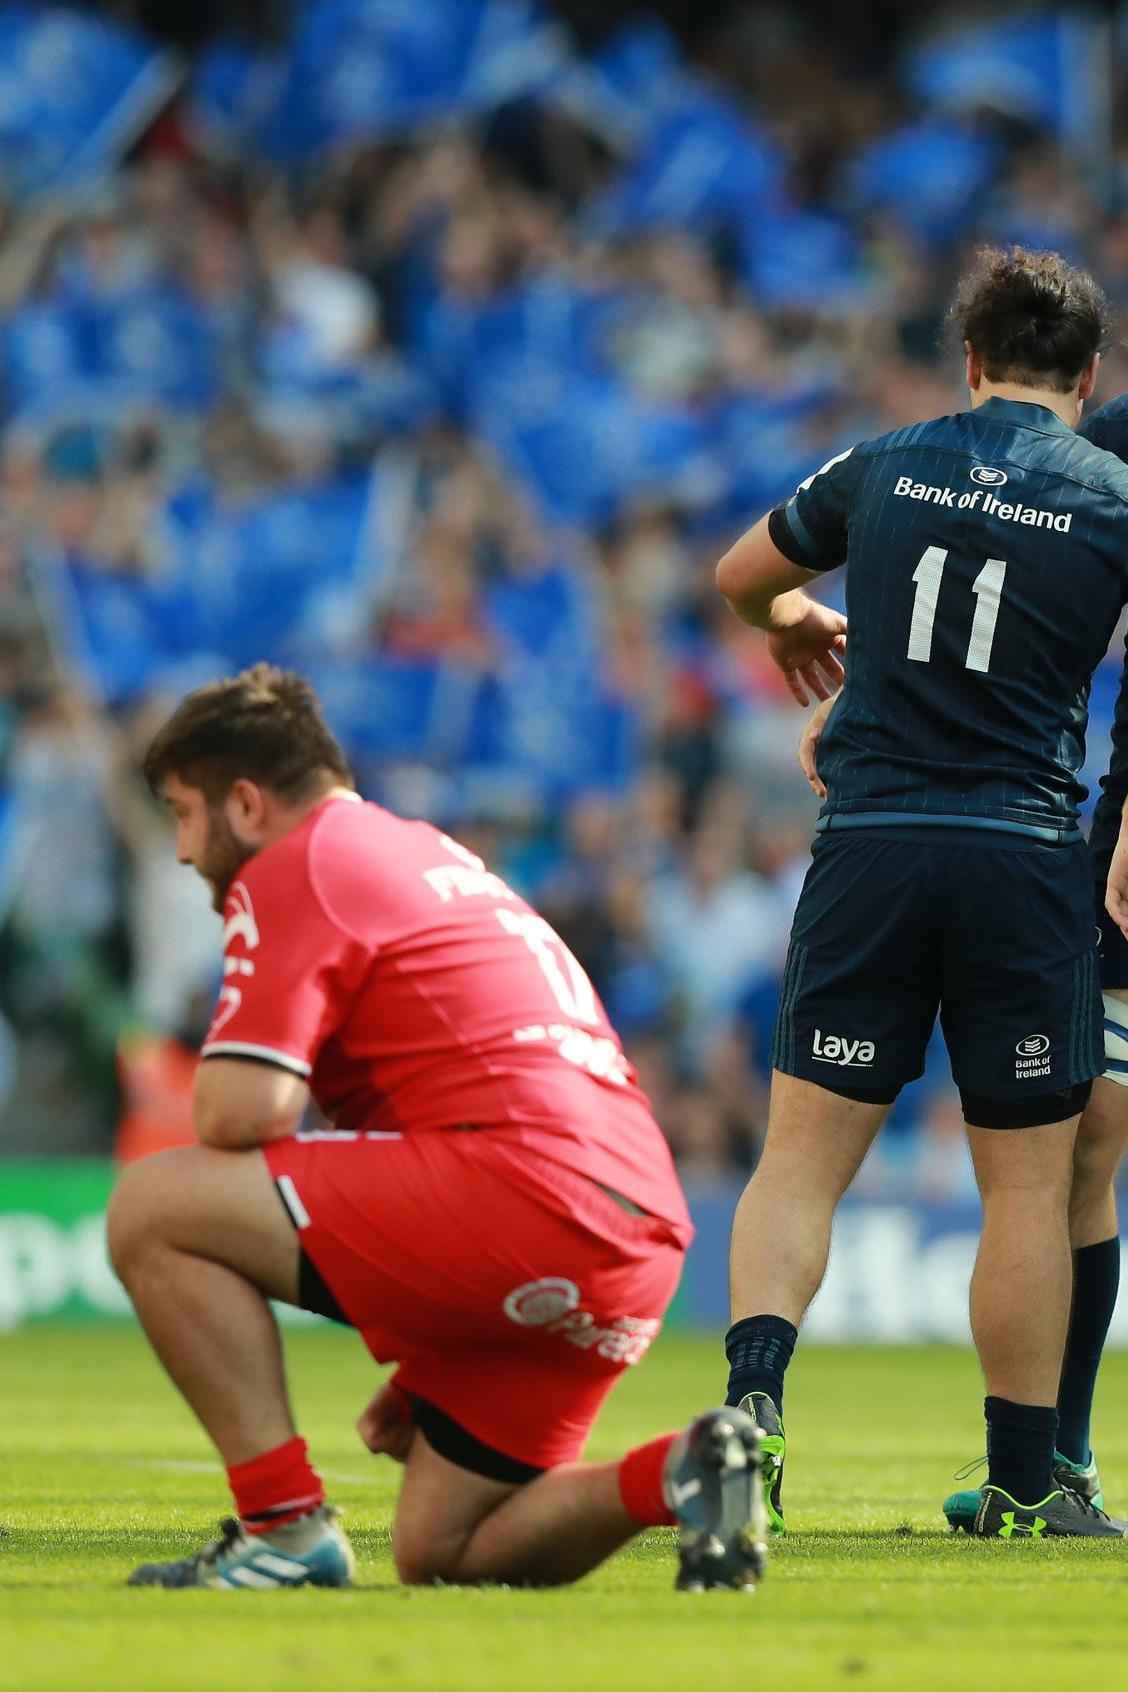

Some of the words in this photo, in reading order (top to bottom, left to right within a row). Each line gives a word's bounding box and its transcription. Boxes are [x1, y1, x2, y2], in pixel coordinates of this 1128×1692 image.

[893, 476, 958, 508] Bank
[958, 490, 984, 509] of
[982, 493, 1073, 533] Ireland
[907, 545, 1007, 673] 11
[812, 1029, 875, 1066] laya
[1015, 1058, 1041, 1069] Bank
[1041, 1055, 1052, 1065] of
[1015, 1065, 1052, 1079] Ireland
